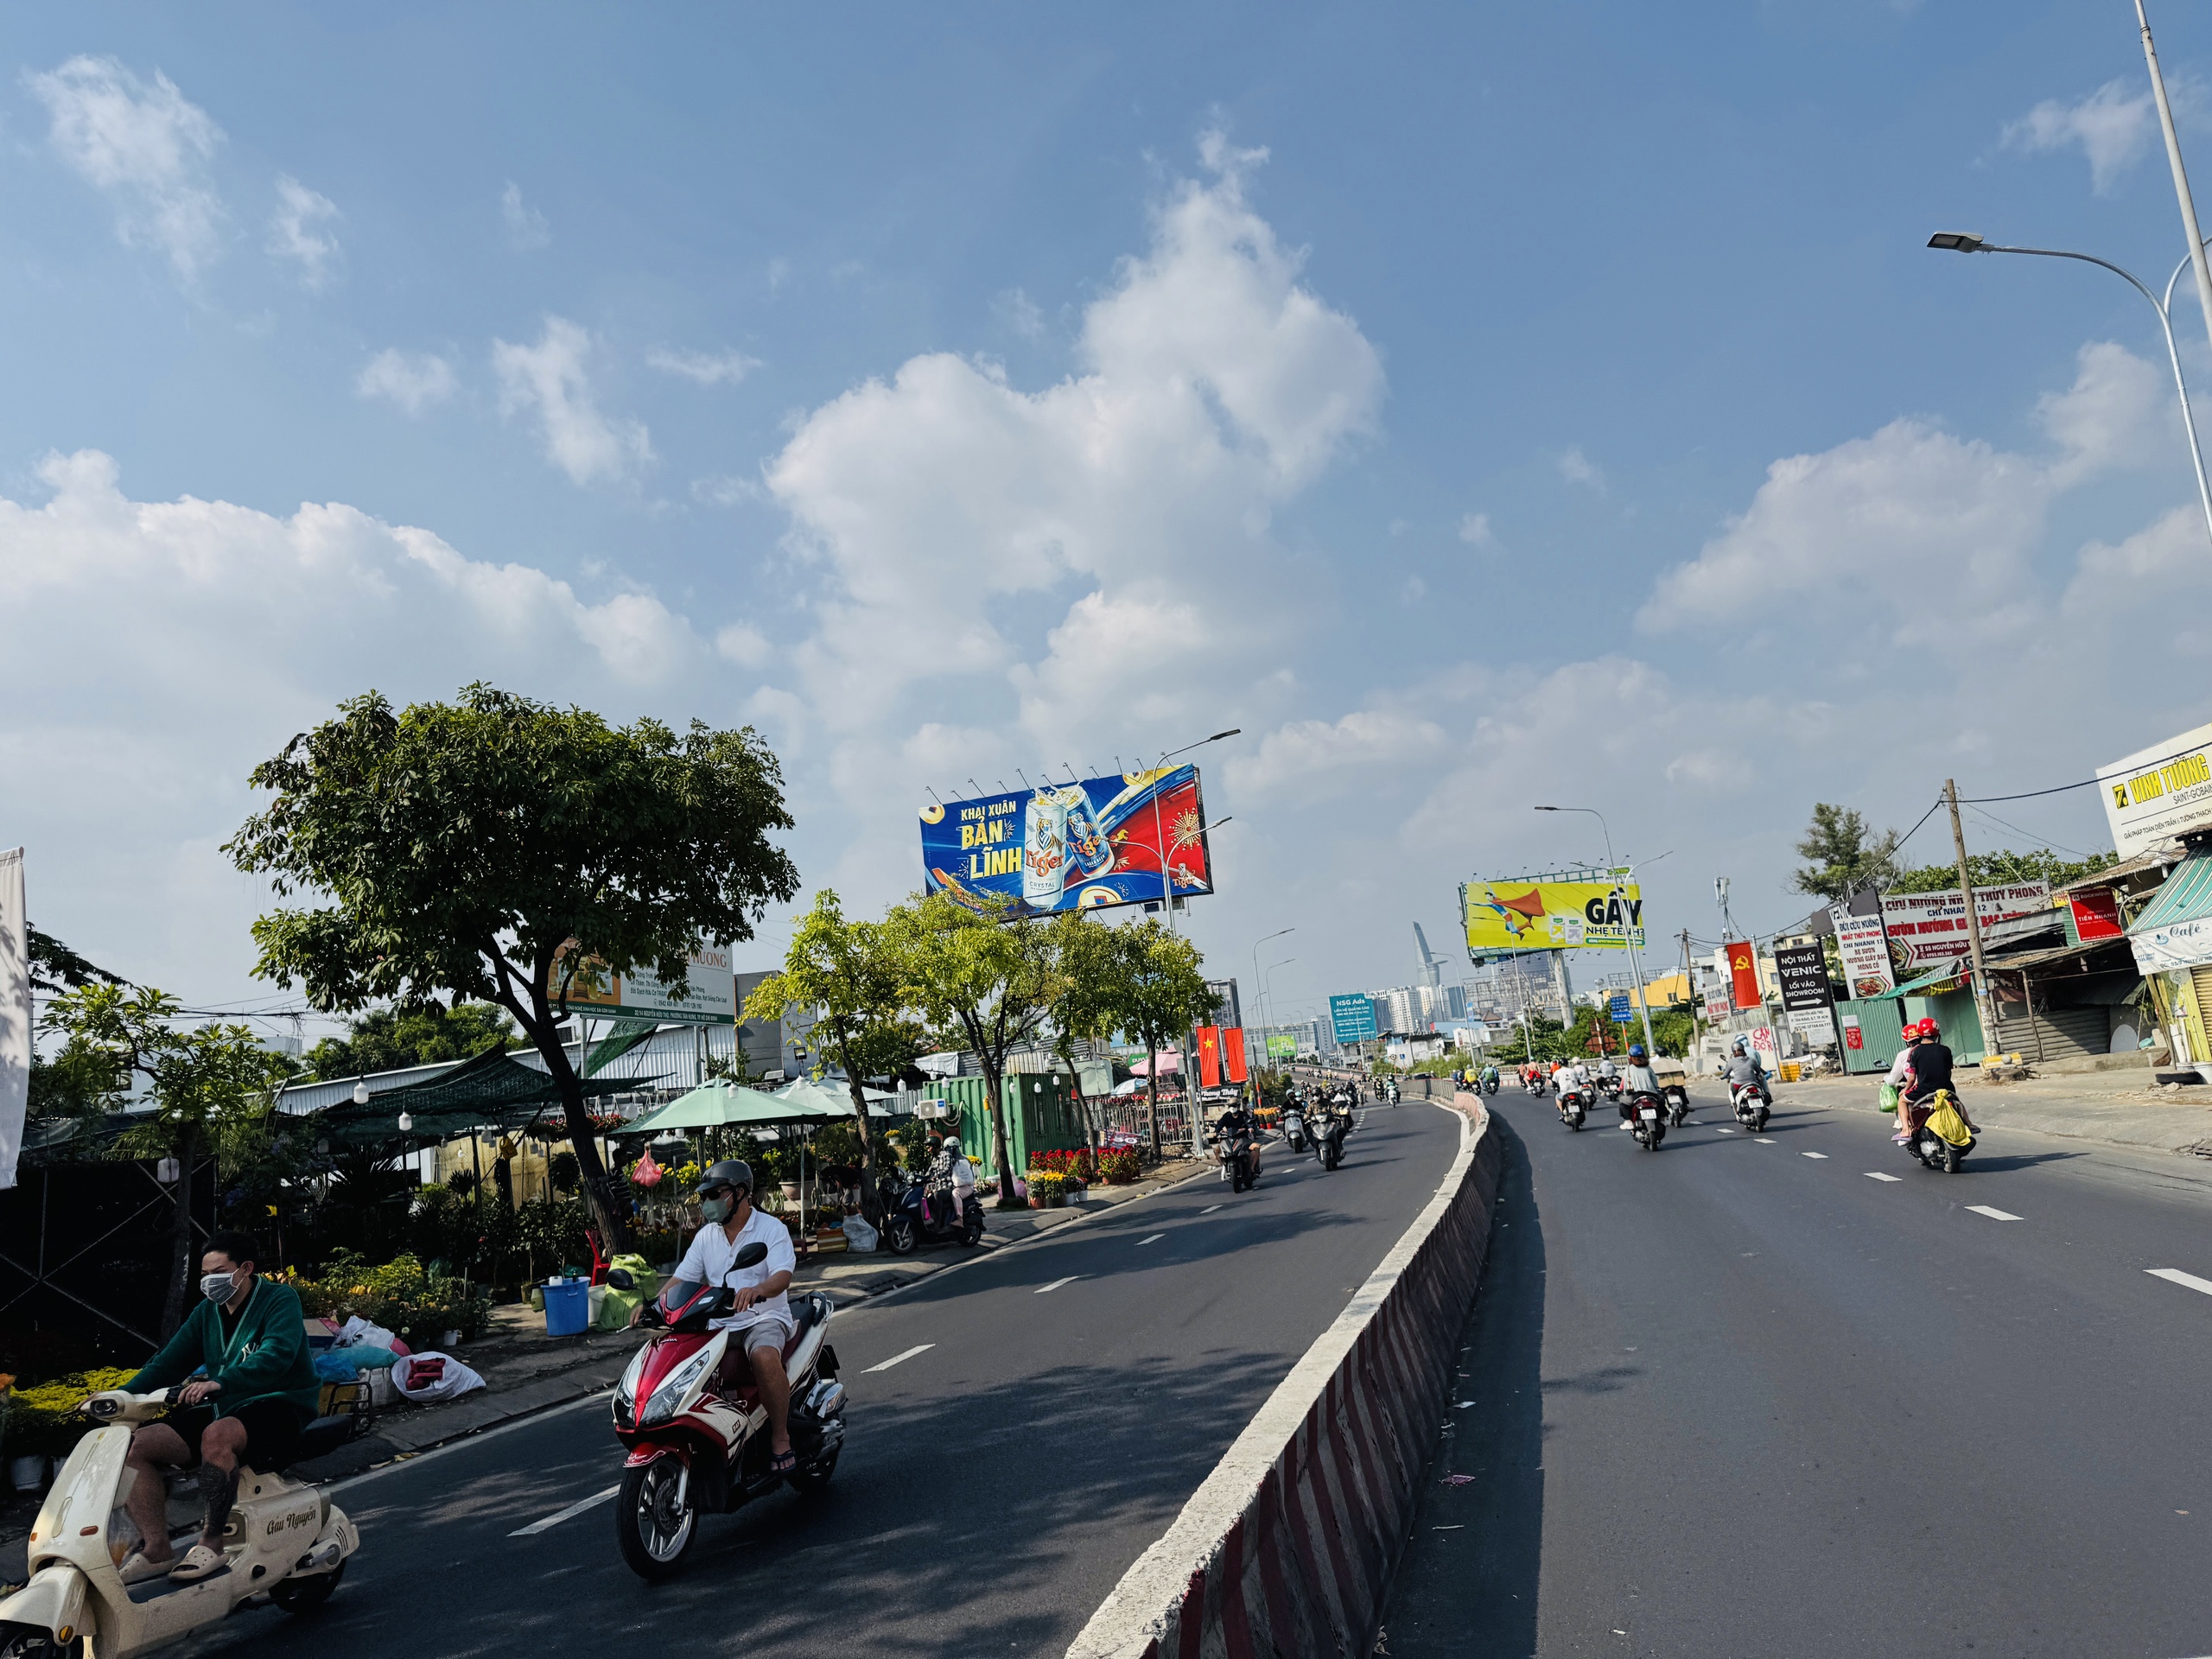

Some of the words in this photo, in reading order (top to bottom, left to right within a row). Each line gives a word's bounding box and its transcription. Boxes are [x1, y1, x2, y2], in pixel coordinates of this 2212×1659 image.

[2128, 771, 2164, 804] VĨNH
[2159, 753, 2211, 793] TƯỜNG
[961, 806, 985, 821] KHAI
[988, 800, 1016, 817] XUÂN
[961, 815, 1002, 850] BẢN
[969, 846, 1021, 880] LĨNH
[1026, 849, 1064, 877] Tiger
[2007, 886, 2044, 899] PHONG
[1586, 927, 1608, 937] NHẸ
[1781, 956, 1796, 965] NỘI
[1797, 952, 1815, 963] THẤT
[1781, 965, 1821, 977] VENIC
[1789, 981, 1800, 989] LỐI
[1785, 988, 1824, 998] SHOWROOM
